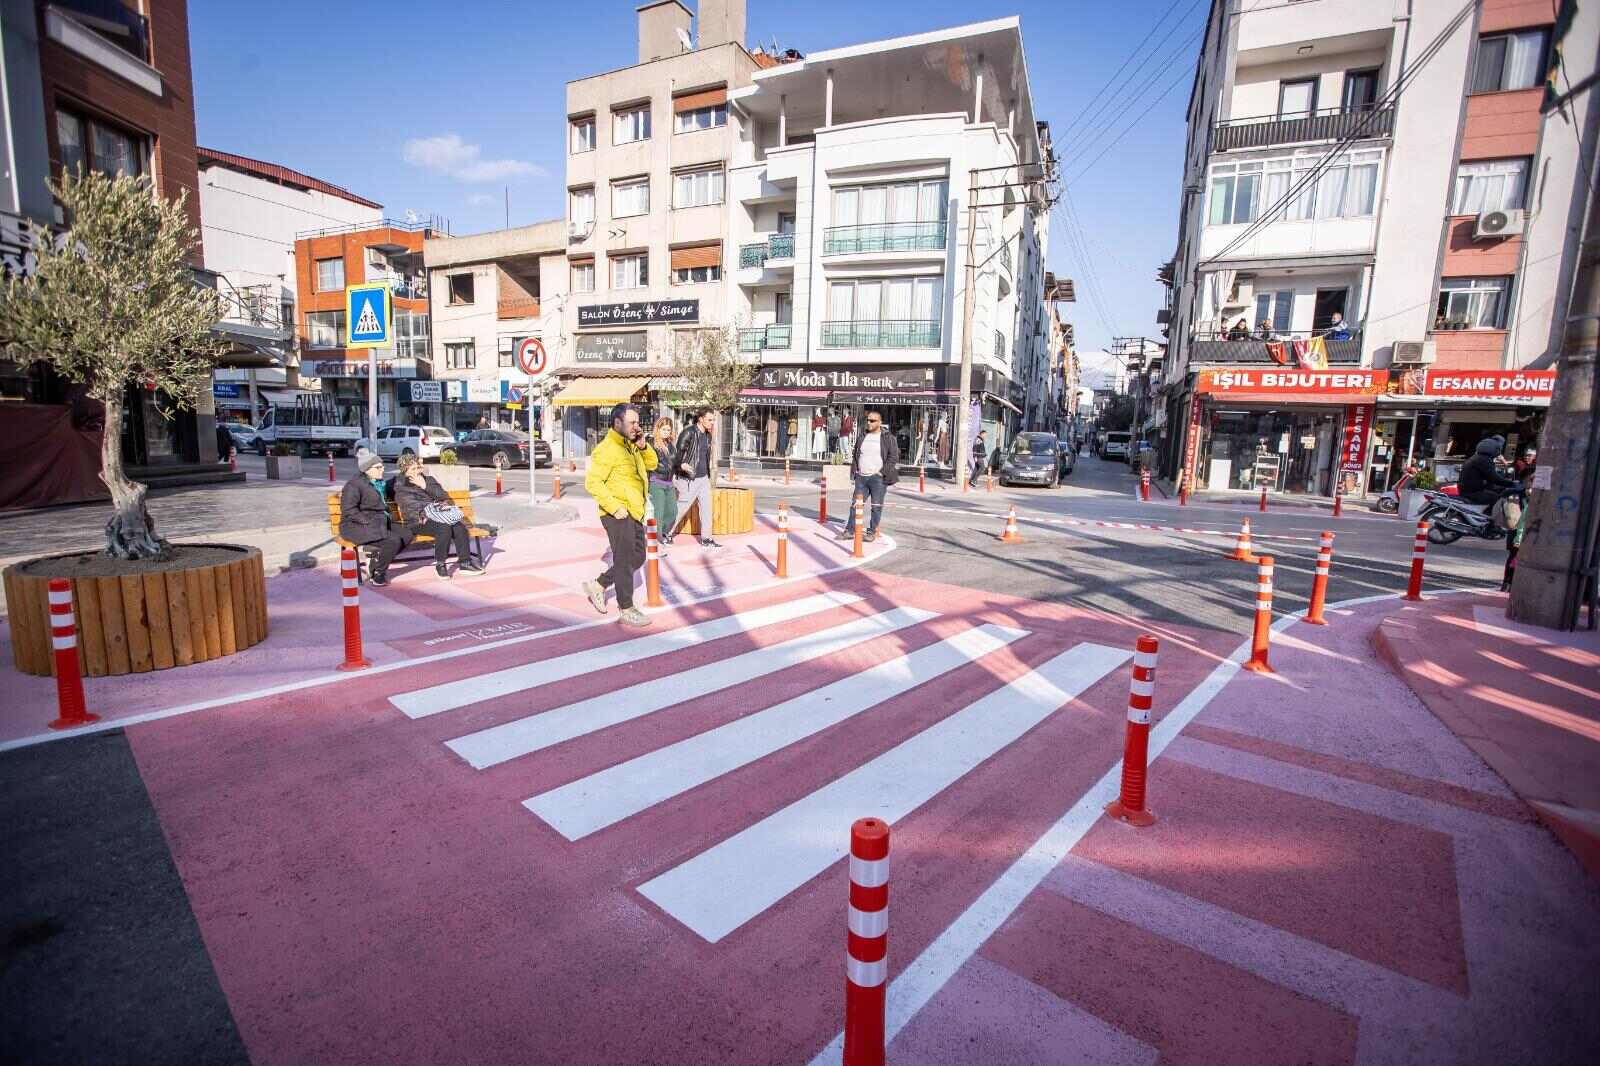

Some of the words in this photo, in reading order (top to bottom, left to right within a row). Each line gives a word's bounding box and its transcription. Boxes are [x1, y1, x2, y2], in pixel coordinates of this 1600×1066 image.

[581, 310, 610, 320] SALON
[660, 304, 694, 317] Simge
[595, 337, 625, 345] SALON
[783, 368, 826, 387] Moda
[829, 369, 858, 387] Lila
[861, 375, 893, 390] Butik
[1213, 373, 1255, 390] IŞIL
[1432, 377, 1496, 390] EFSANE
[1350, 406, 1365, 461] EFSANE
